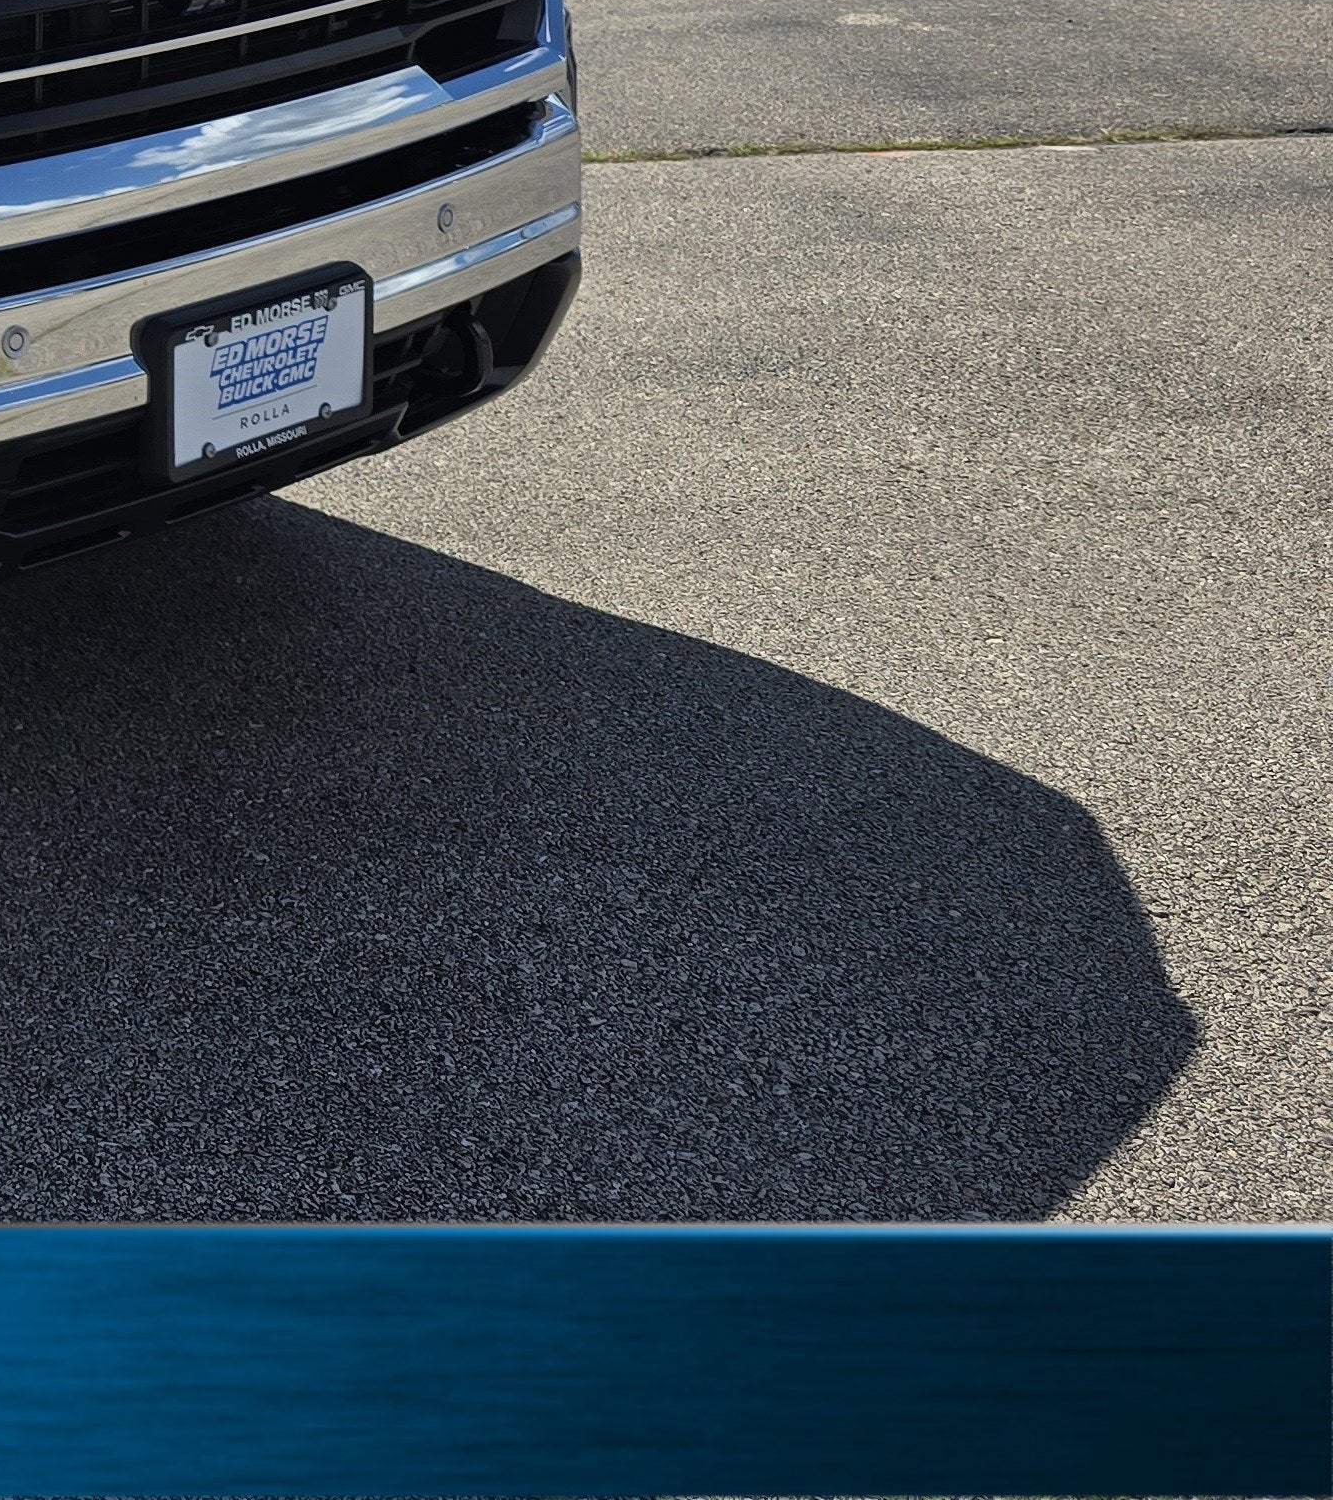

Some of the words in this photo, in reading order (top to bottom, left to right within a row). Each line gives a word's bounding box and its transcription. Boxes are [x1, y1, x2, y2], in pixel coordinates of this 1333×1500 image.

[338, 280, 365, 296] GMC
[230, 312, 252, 333] ED
[255, 296, 310, 326] MORSE
[212, 343, 245, 372] ED
[244, 317, 326, 362] MORSE
[220, 342, 318, 387] CHEVROLET
[239, 403, 290, 429] ROLLA
[265, 424, 308, 450] MISSOURI
